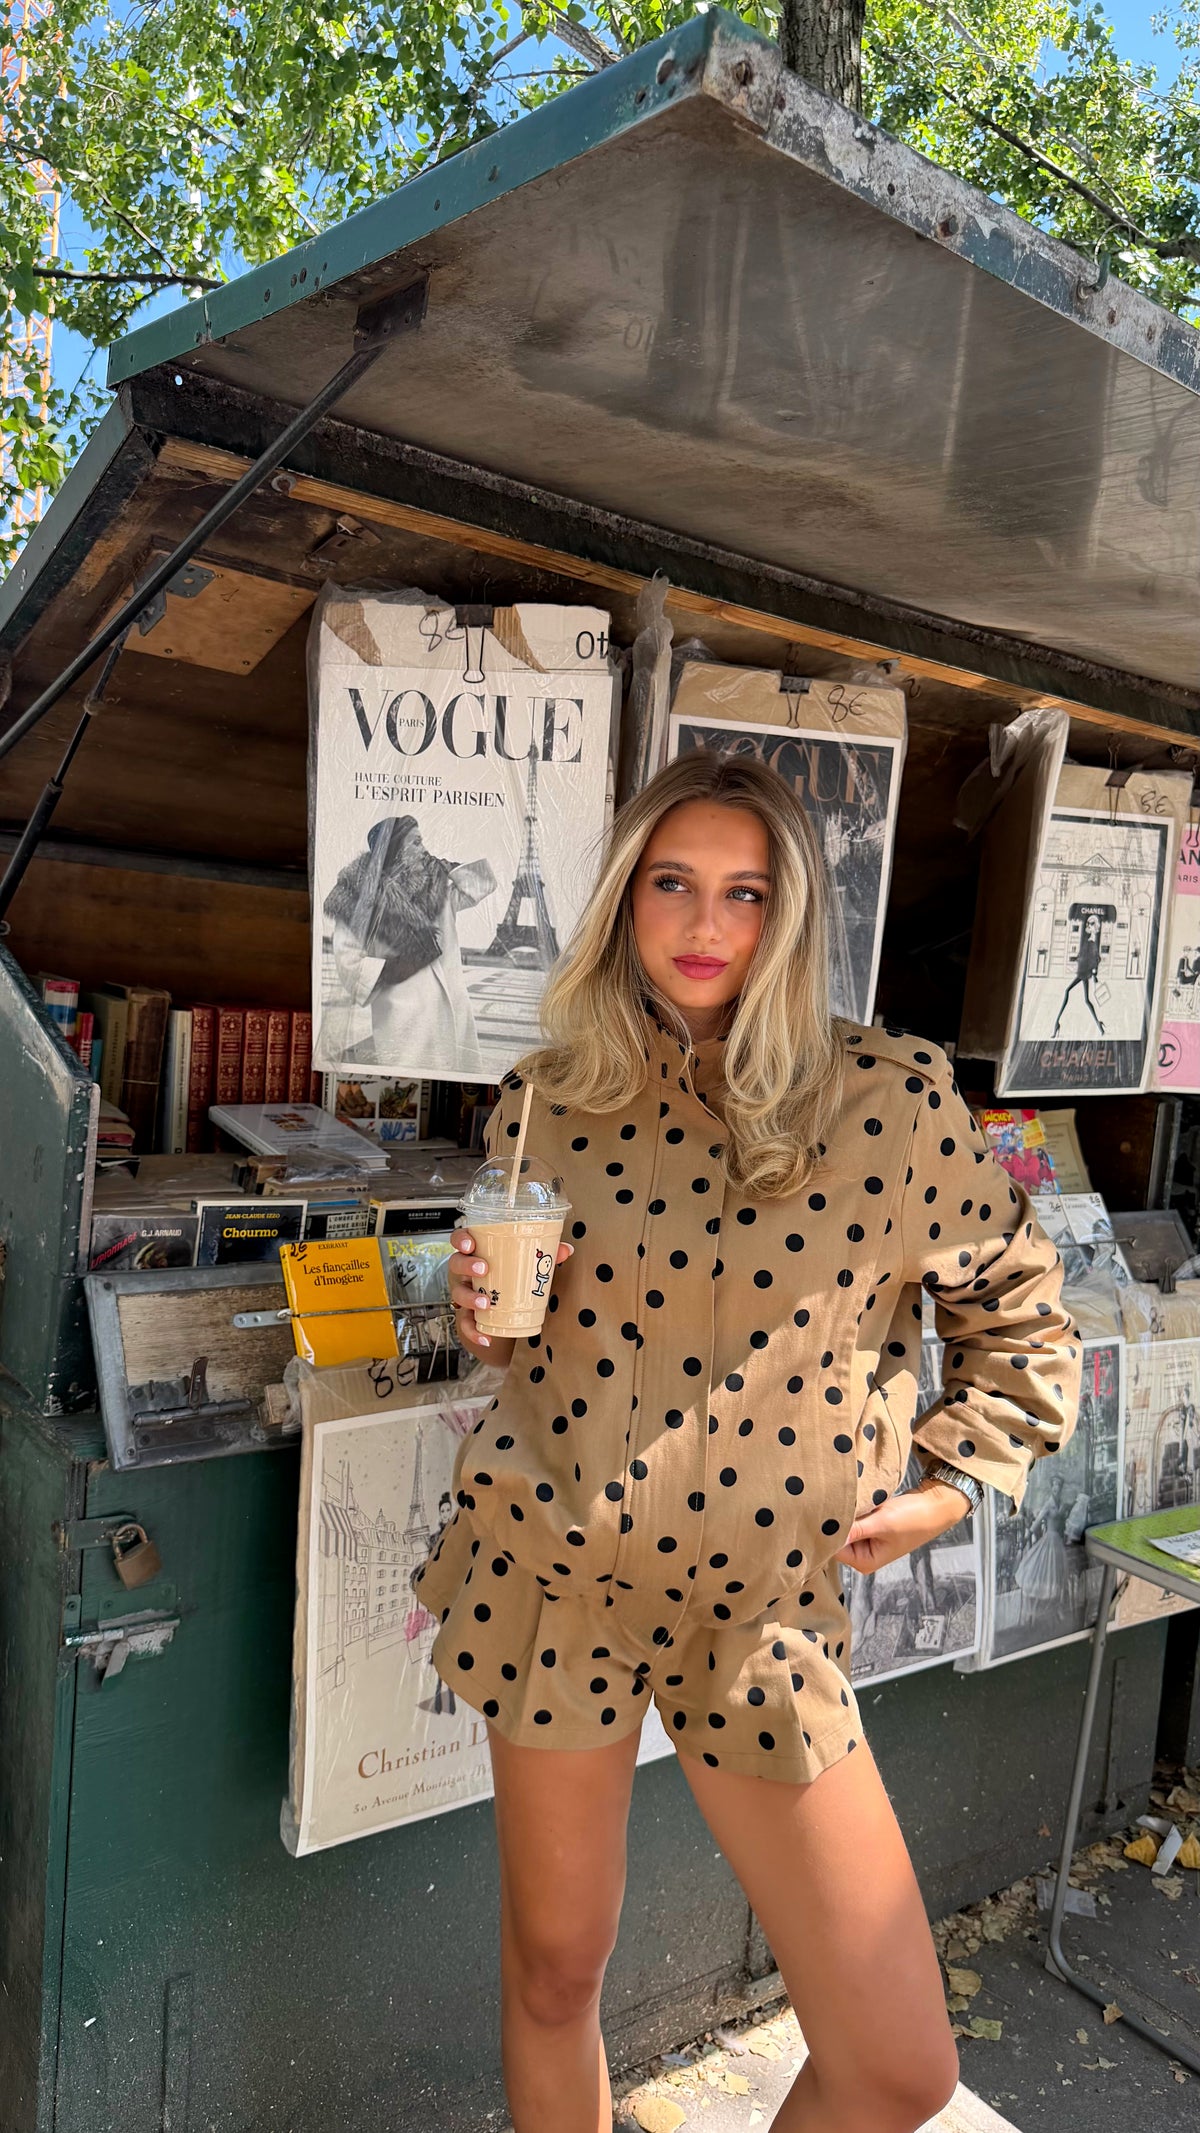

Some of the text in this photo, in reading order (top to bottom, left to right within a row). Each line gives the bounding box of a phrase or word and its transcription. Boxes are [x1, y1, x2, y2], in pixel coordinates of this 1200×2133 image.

[343, 687, 584, 763] VOGUE
[399, 717, 425, 729] PARIS
[354, 772, 442, 787] HAUTE COUTURE
[354, 784, 507, 807] L'ESPRIT PARISIEN
[1080, 907, 1105, 915] CHANEL
[1040, 1049, 1117, 1068] CHANEL
[984, 1112, 1012, 1122] MICKEY
[154, 1229, 182, 1237] ARNAUD
[223, 1227, 278, 1238] Chourmo
[328, 1222, 350, 1231] HOMME
[303, 1259, 370, 1275] Les fiançailles
[314, 1273, 364, 1287] d'Imogène
[357, 1740, 461, 1779] Christian
[353, 1803, 368, 1815] 50
[371, 1791, 410, 1808] Avenue
